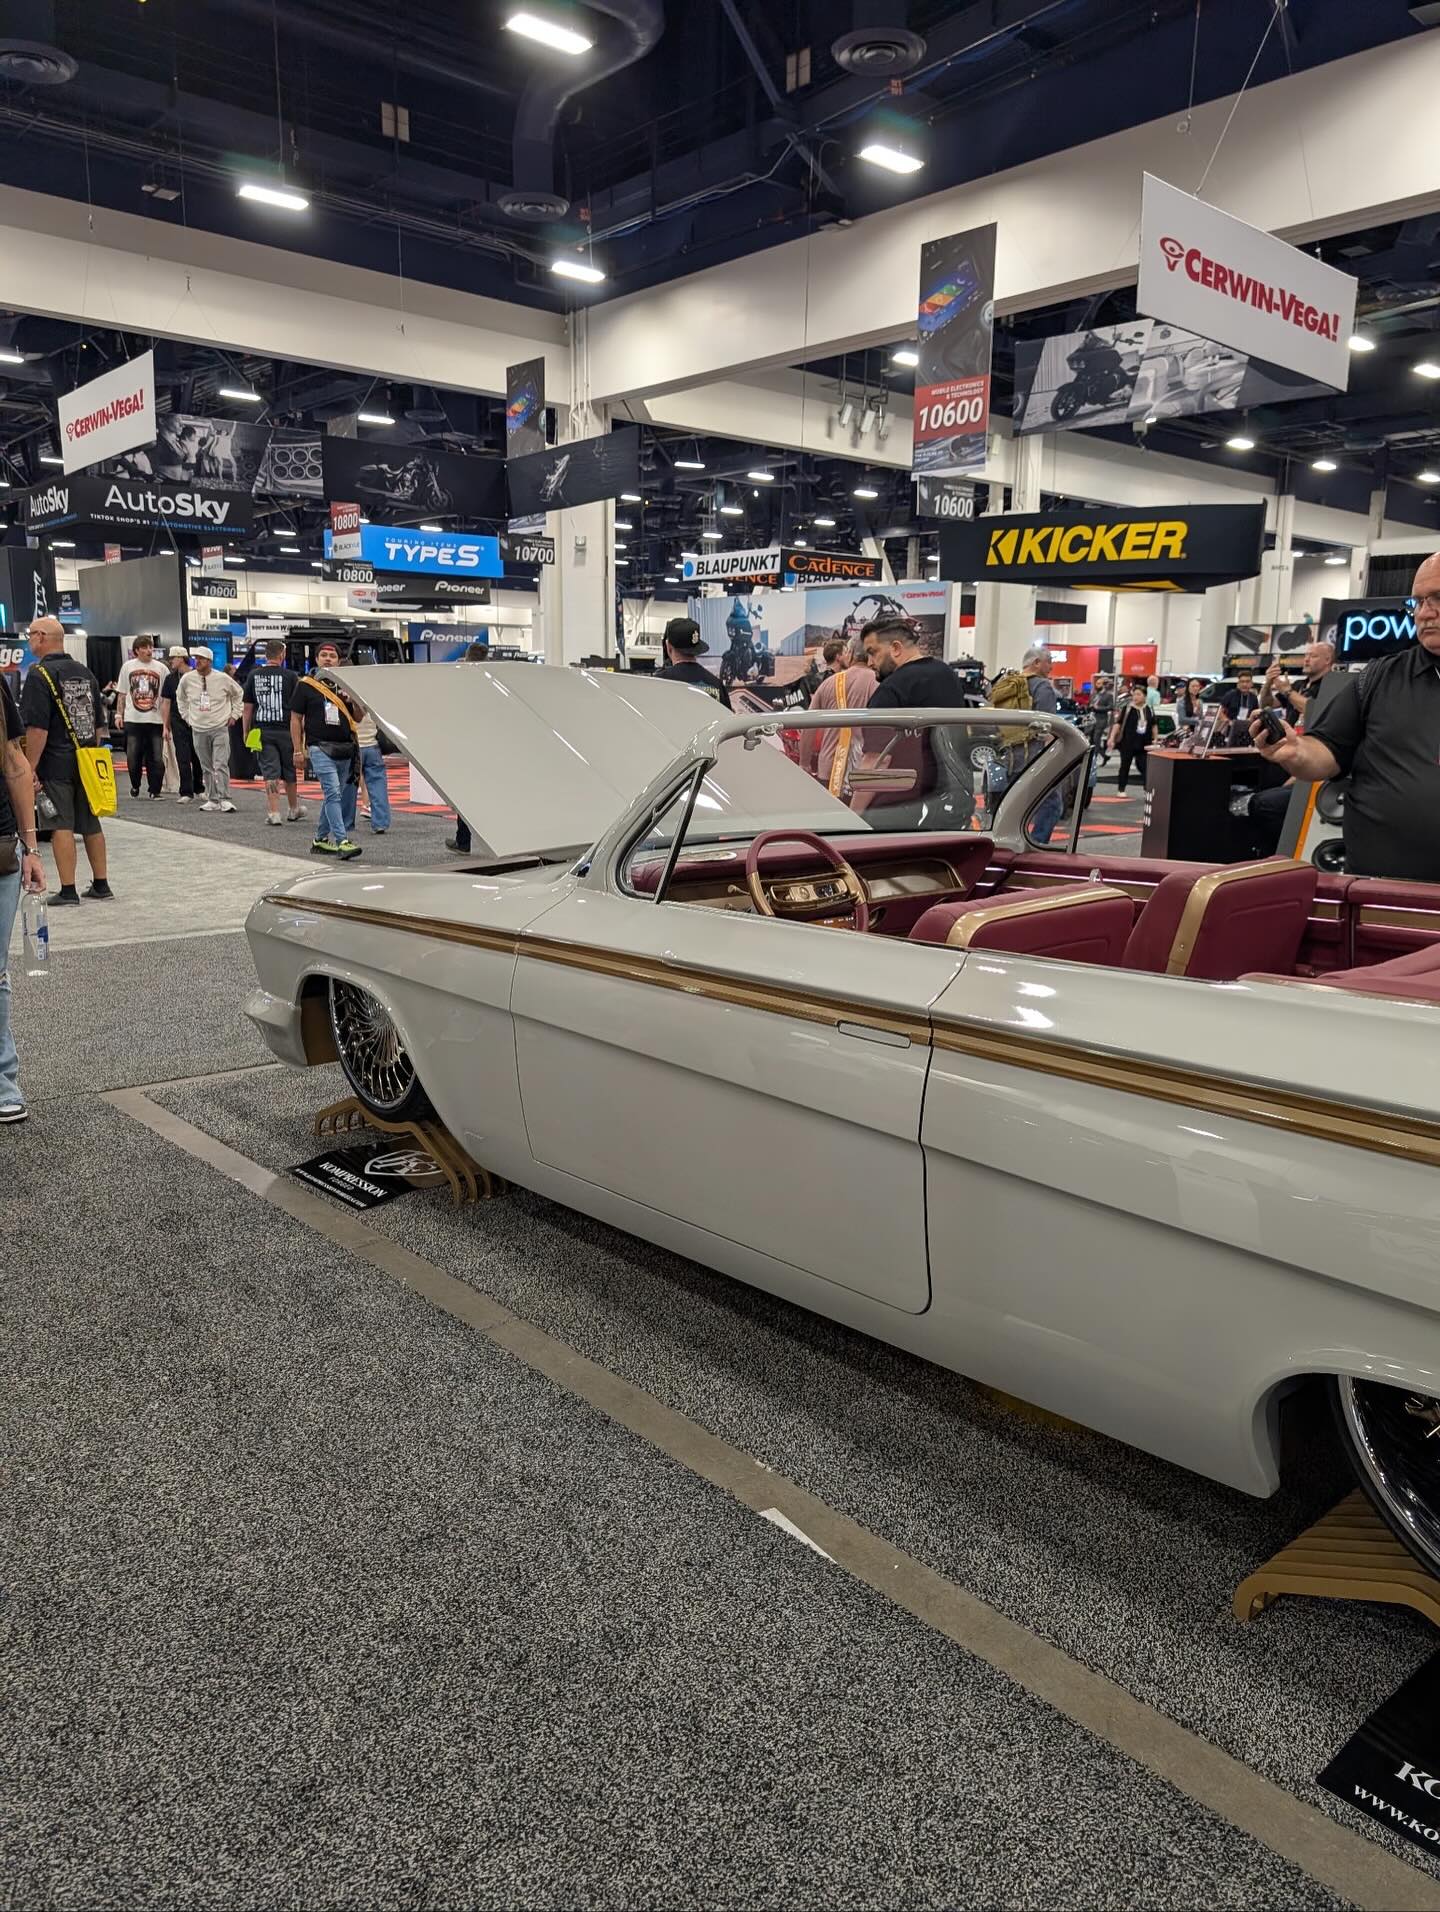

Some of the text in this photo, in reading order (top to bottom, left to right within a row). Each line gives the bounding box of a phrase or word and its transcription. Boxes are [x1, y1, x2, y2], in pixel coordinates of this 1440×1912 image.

[1185, 248, 1339, 342] CERWIN-VEGA!
[74, 389, 145, 438] CERWIN-VEGA!
[920, 397, 984, 432] 10600
[30, 486, 69, 518] AutoSky
[105, 485, 230, 524] AutoSky
[934, 495, 974, 518] 10600
[333, 513, 358, 531] 10800
[385, 542, 480, 567] TYPES
[514, 546, 554, 563] 10700
[1016, 521, 1187, 565] KICKER
[336, 568, 373, 583] 10800
[696, 554, 780, 575] BLAUPUNKT
[203, 585, 236, 598] 10900
[435, 581, 485, 595] Pioneer
[420, 629, 480, 643] Pioneer
[319, 1161, 388, 1198] KOMPRESSION
